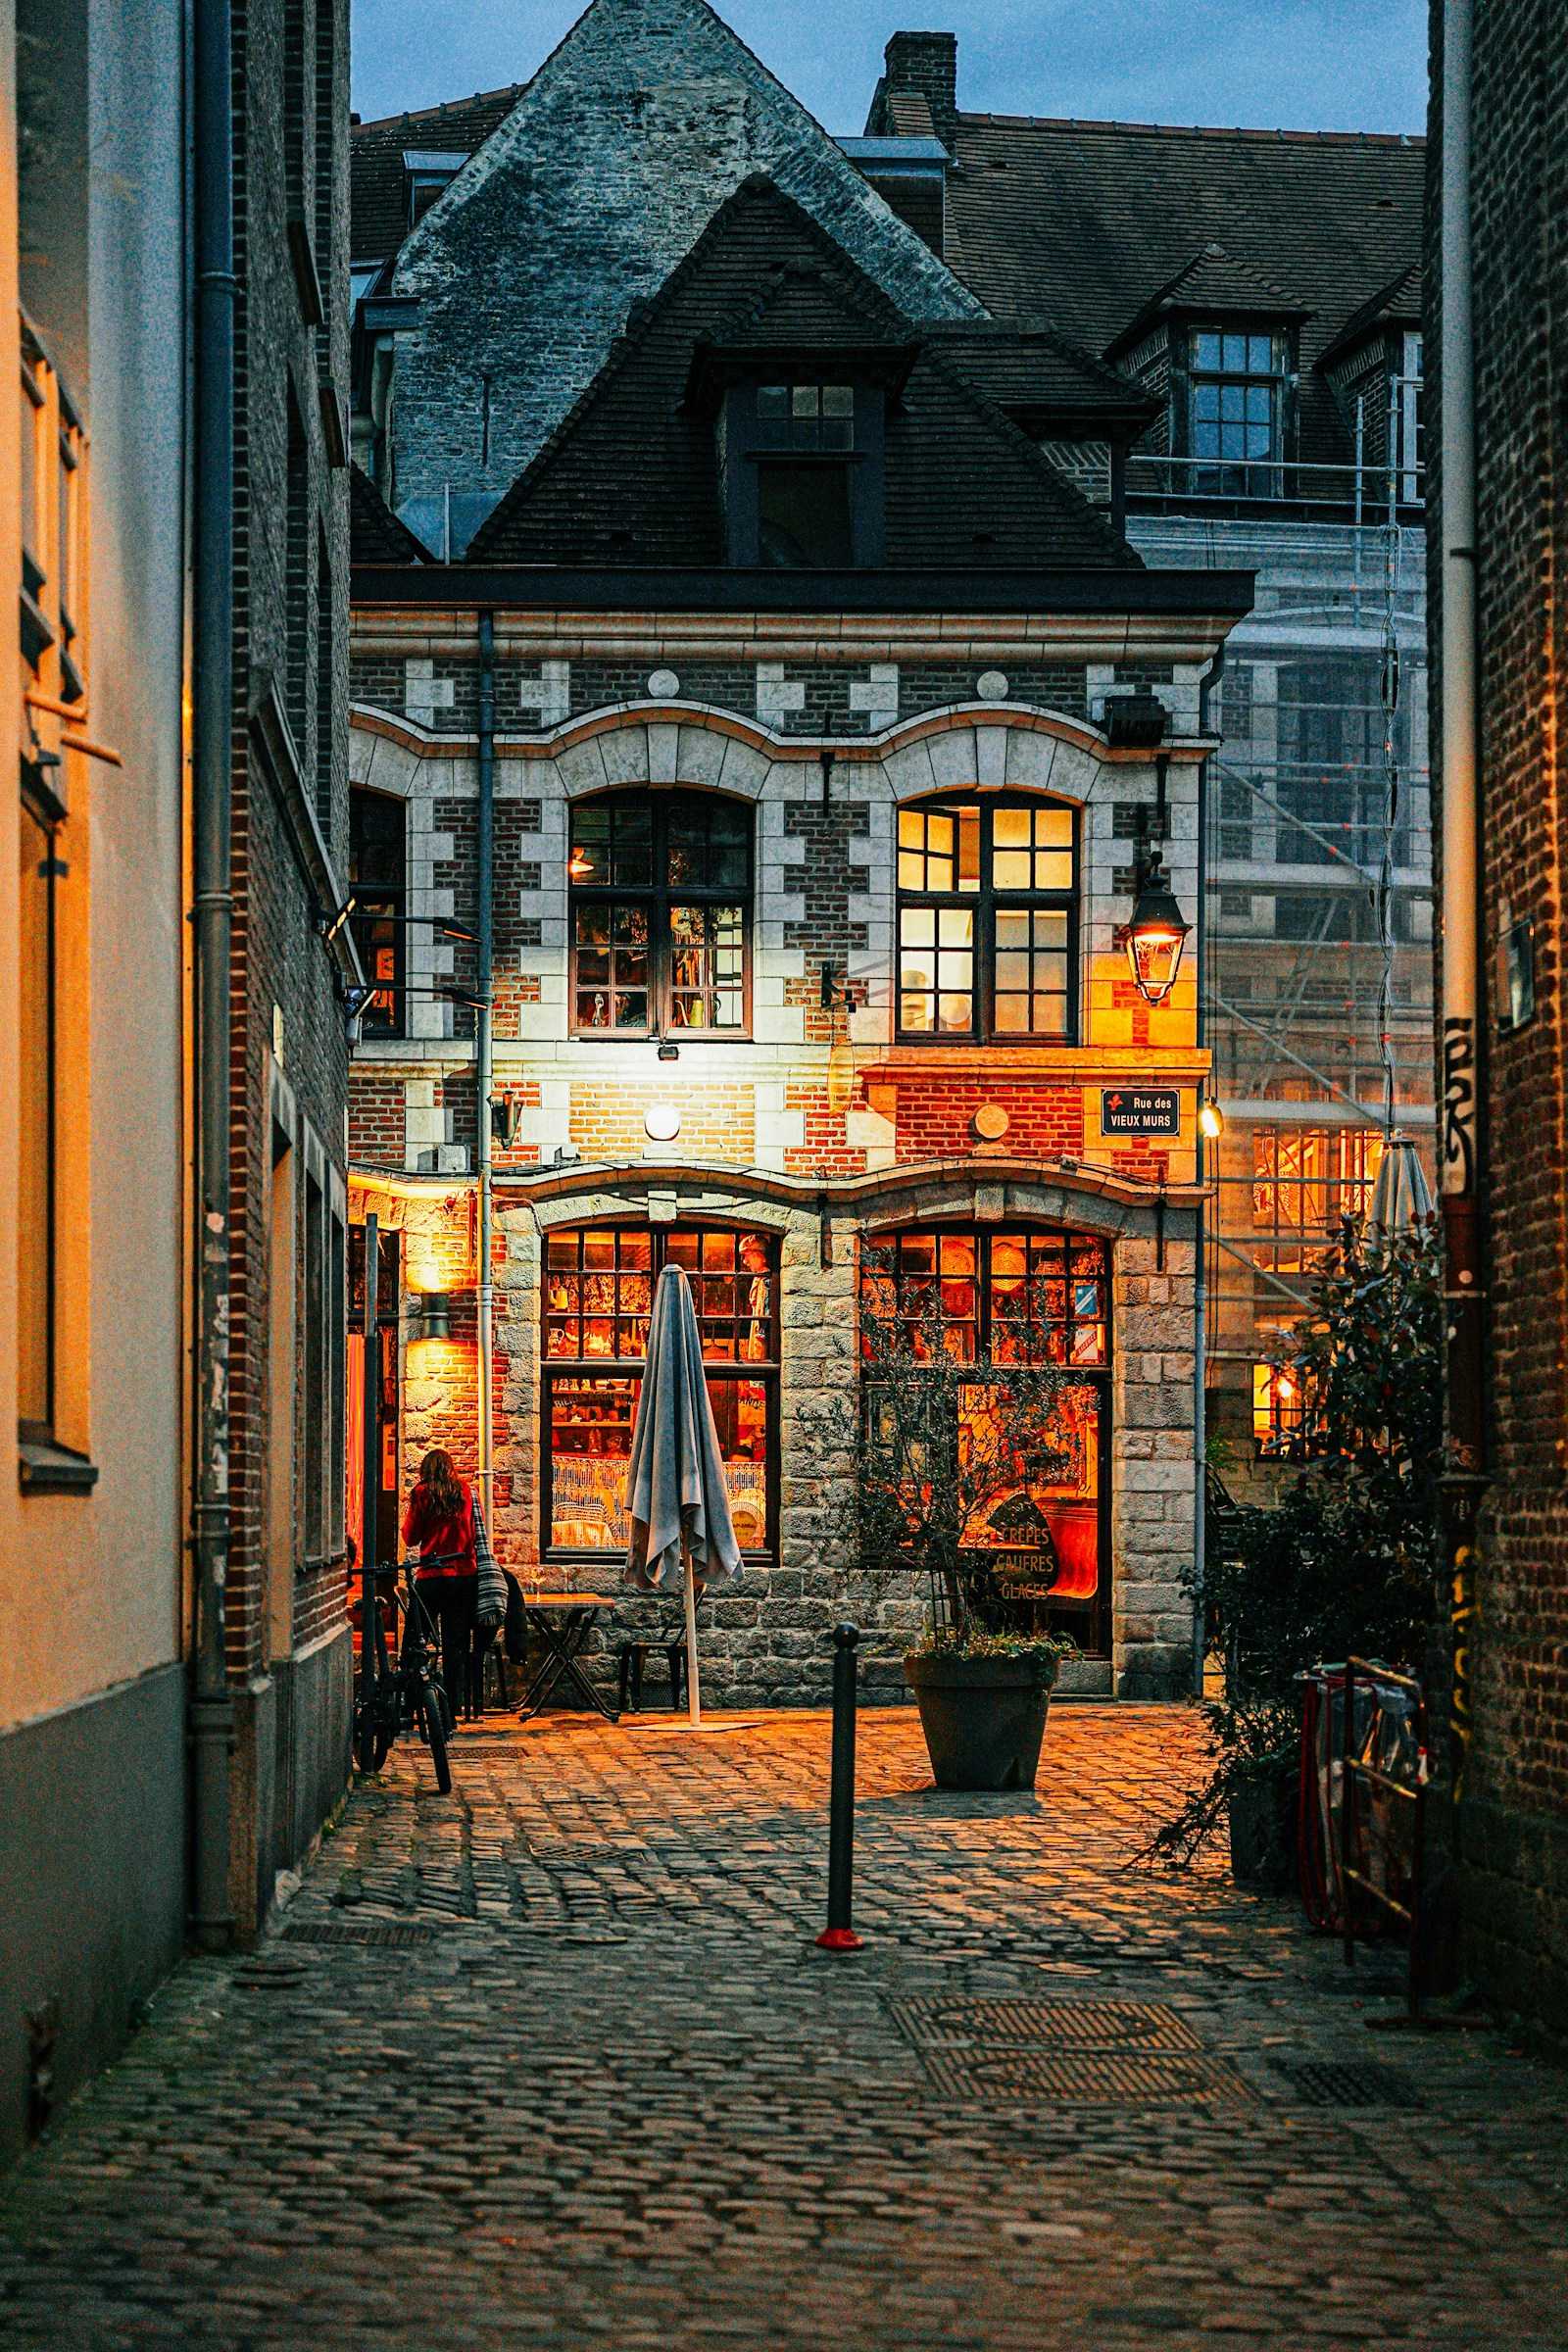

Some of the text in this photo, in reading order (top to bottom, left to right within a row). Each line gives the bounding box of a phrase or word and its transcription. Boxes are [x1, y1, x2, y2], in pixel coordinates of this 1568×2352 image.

[1134, 1097, 1172, 1109] Rue des
[1110, 1114, 1171, 1127] VIEUX MURS
[1003, 1524, 1051, 1544] CRÊPES
[1002, 1583, 1049, 1600] GLACES
